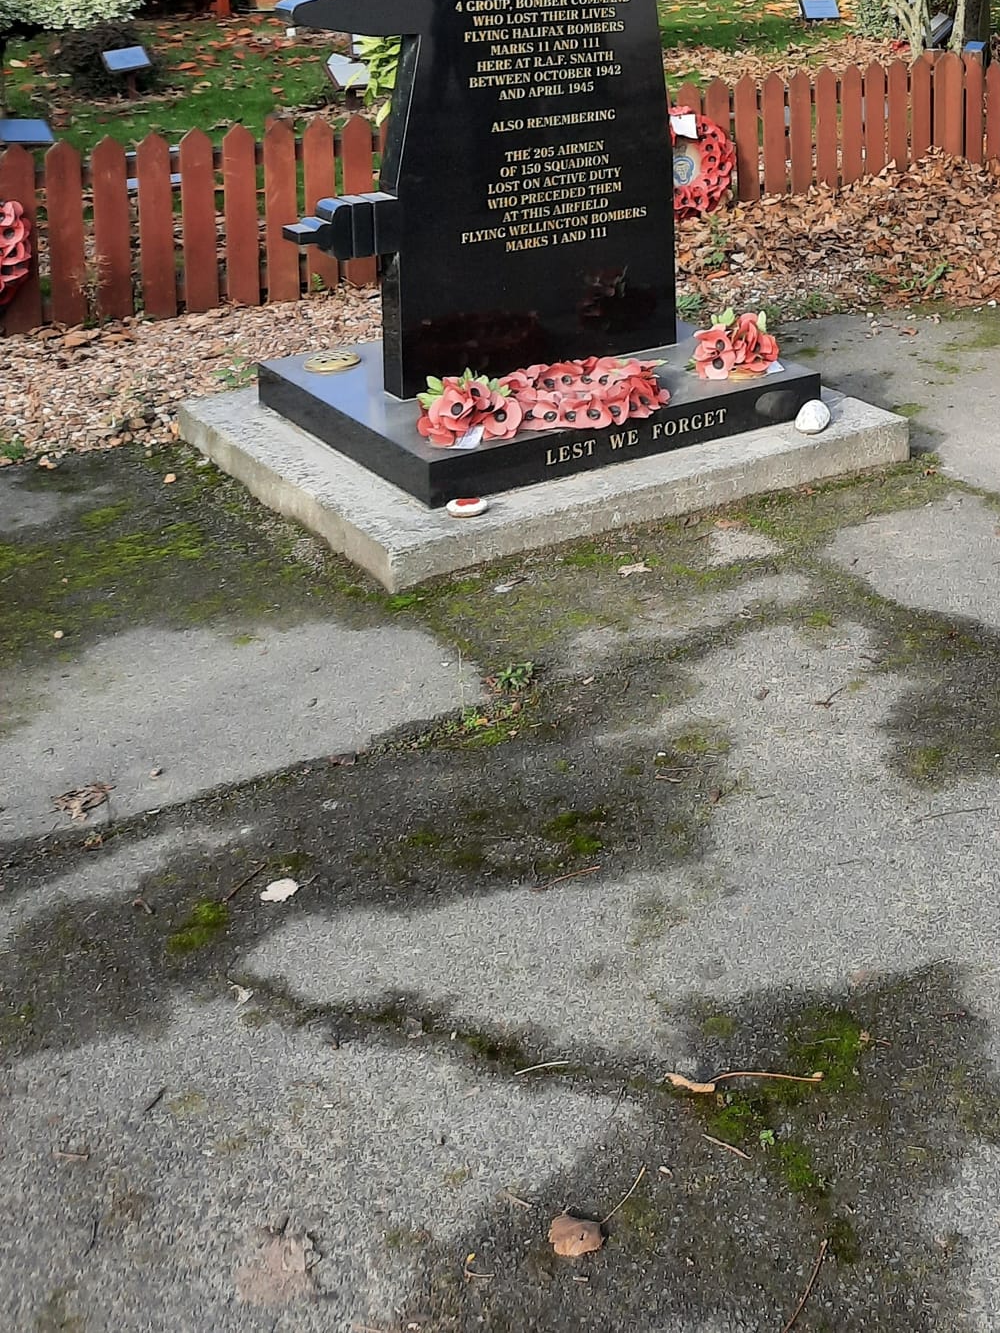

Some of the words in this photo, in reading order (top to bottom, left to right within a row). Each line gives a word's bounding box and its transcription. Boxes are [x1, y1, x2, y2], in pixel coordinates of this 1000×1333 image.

[455, 2, 462, 12] 4
[466, 0, 512, 11] GROUP,
[473, 15, 503, 26] WHO
[507, 13, 539, 24] LOST
[541, 10, 578, 22] THEIR
[582, 7, 615, 19] LIVES
[464, 29, 509, 42] FLYING
[512, 25, 564, 39] HALIFAX
[567, 21, 624, 35] BOMBERS
[491, 43, 534, 56] MARKS
[553, 39, 578, 50] AND
[477, 60, 511, 72] HERE
[515, 58, 531, 68] AT
[534, 55, 567, 66] R.A.F.
[570, 51, 613, 64] SNAITH
[469, 73, 530, 88] BETWEEN
[534, 67, 592, 82] OCTOBER
[596, 66, 621, 76] 1942
[499, 89, 525, 100] AND
[529, 85, 564, 97] APRIL
[568, 81, 594, 94] 1945
[491, 119, 524, 132] ALSO
[527, 109, 615, 129] REMEMBERING
[505, 150, 530, 162] THE
[533, 147, 554, 158] 205
[557, 140, 604, 155] AIRMEN
[500, 166, 517, 177] OF
[522, 163, 541, 175] 150
[544, 154, 609, 172] SQUADRON
[488, 181, 520, 194] LOST
[523, 178, 540, 190] ON
[543, 172, 586, 186] ACTIVE
[590, 167, 621, 181] DUTY
[488, 196, 517, 209] WHO
[521, 187, 585, 204] PRECEDED
[588, 182, 622, 195] THEM
[502, 211, 519, 223] AT
[521, 206, 550, 219] THIS
[553, 198, 608, 215] AIRFIELD
[461, 228, 506, 244] FLYING
[509, 216, 588, 236] WELLINGTON
[591, 207, 647, 224] BOMBERS
[505, 236, 548, 252] MARKS
[561, 231, 586, 243] AND
[546, 439, 596, 466] LEST
[610, 429, 639, 450] WE
[652, 408, 727, 439] FORGET
